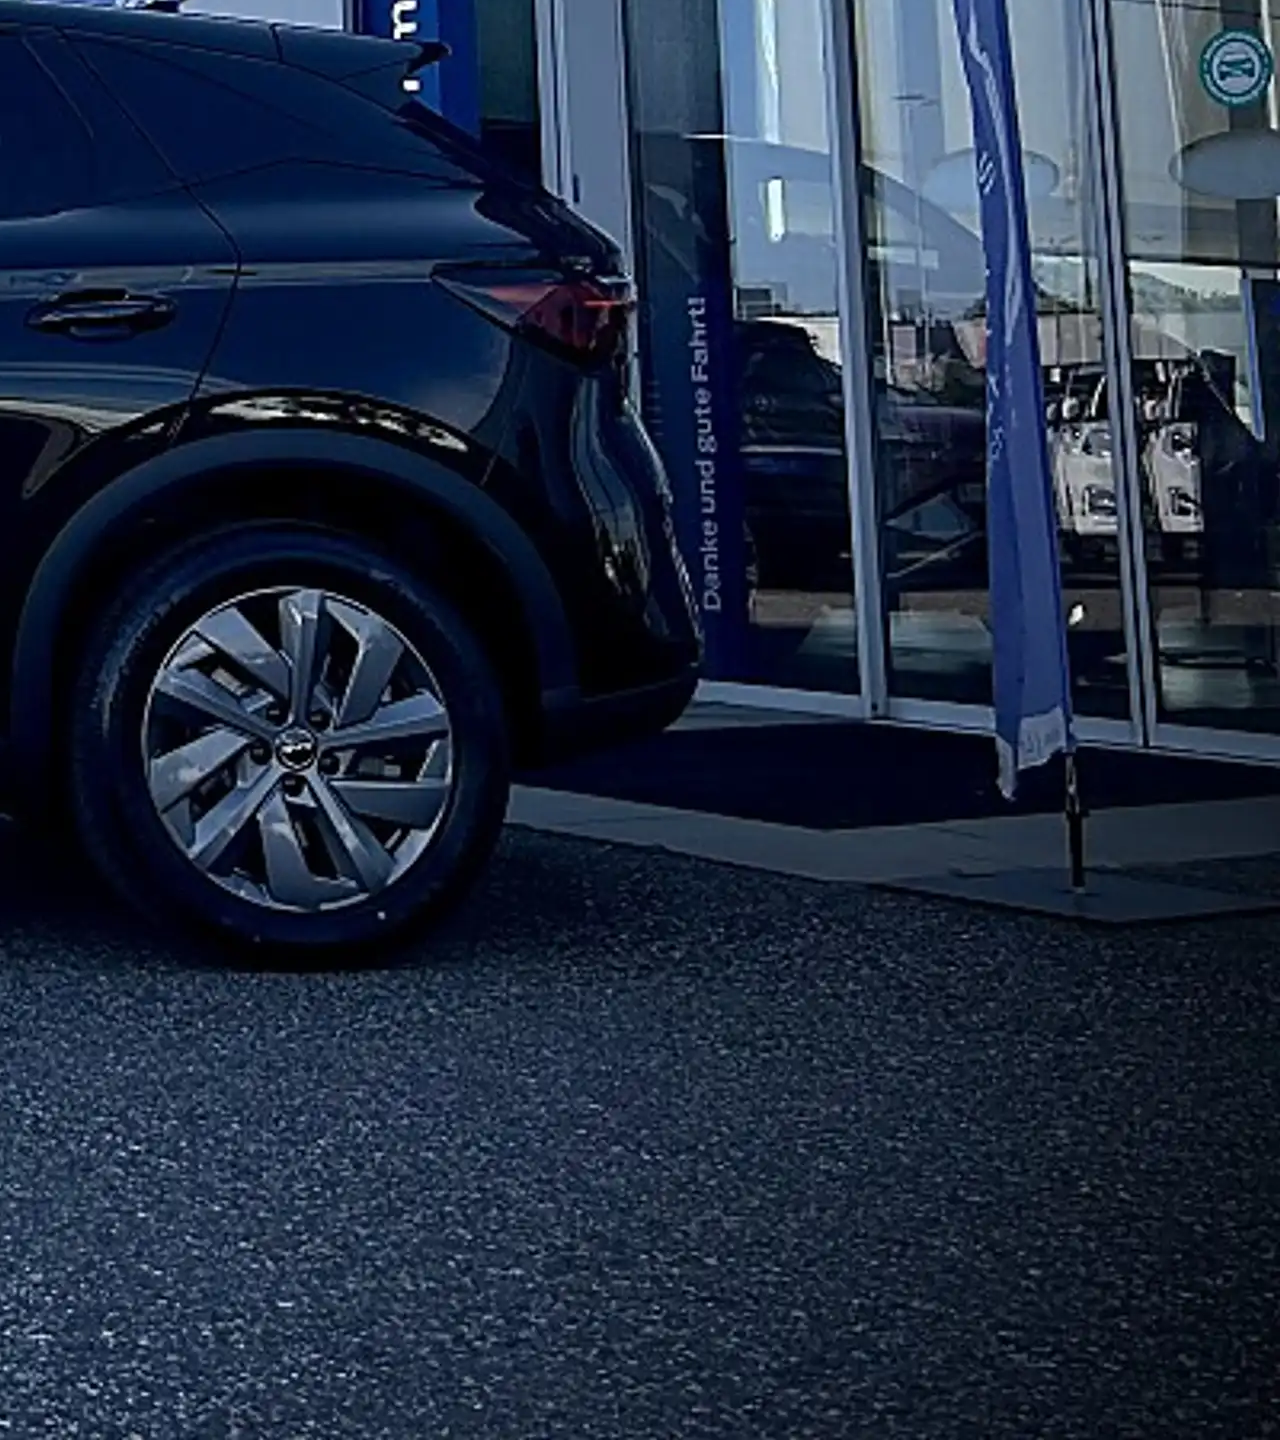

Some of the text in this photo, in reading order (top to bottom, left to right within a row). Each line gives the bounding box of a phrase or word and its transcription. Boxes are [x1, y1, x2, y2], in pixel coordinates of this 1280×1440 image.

[693, 387, 718, 453] gute
[695, 460, 716, 513] und
[699, 518, 721, 610] Danke
